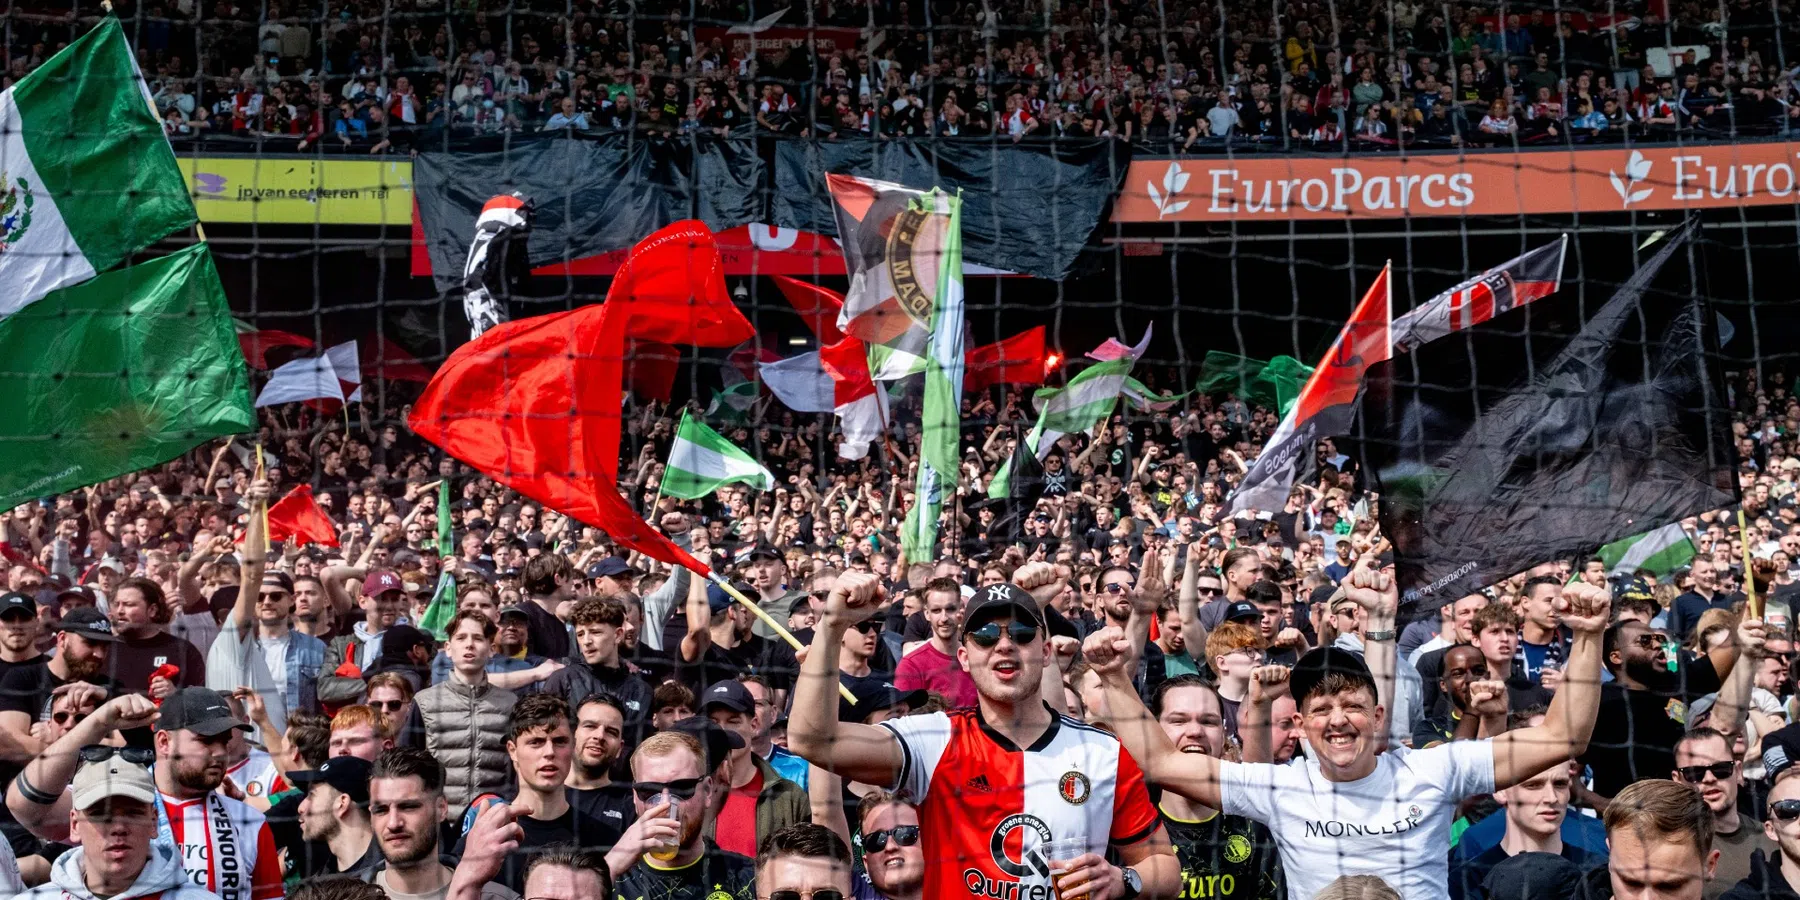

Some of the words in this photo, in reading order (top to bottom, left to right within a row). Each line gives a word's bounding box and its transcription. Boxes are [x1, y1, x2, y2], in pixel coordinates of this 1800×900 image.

[1671, 154, 1800, 200] Euro
[236, 184, 253, 201] jp
[256, 189, 285, 199] van
[1208, 168, 1474, 213] EuroParcs
[987, 584, 1012, 601] NY
[998, 816, 1023, 837] groene
[1024, 816, 1051, 841] energie
[1304, 816, 1419, 838] MONCLER
